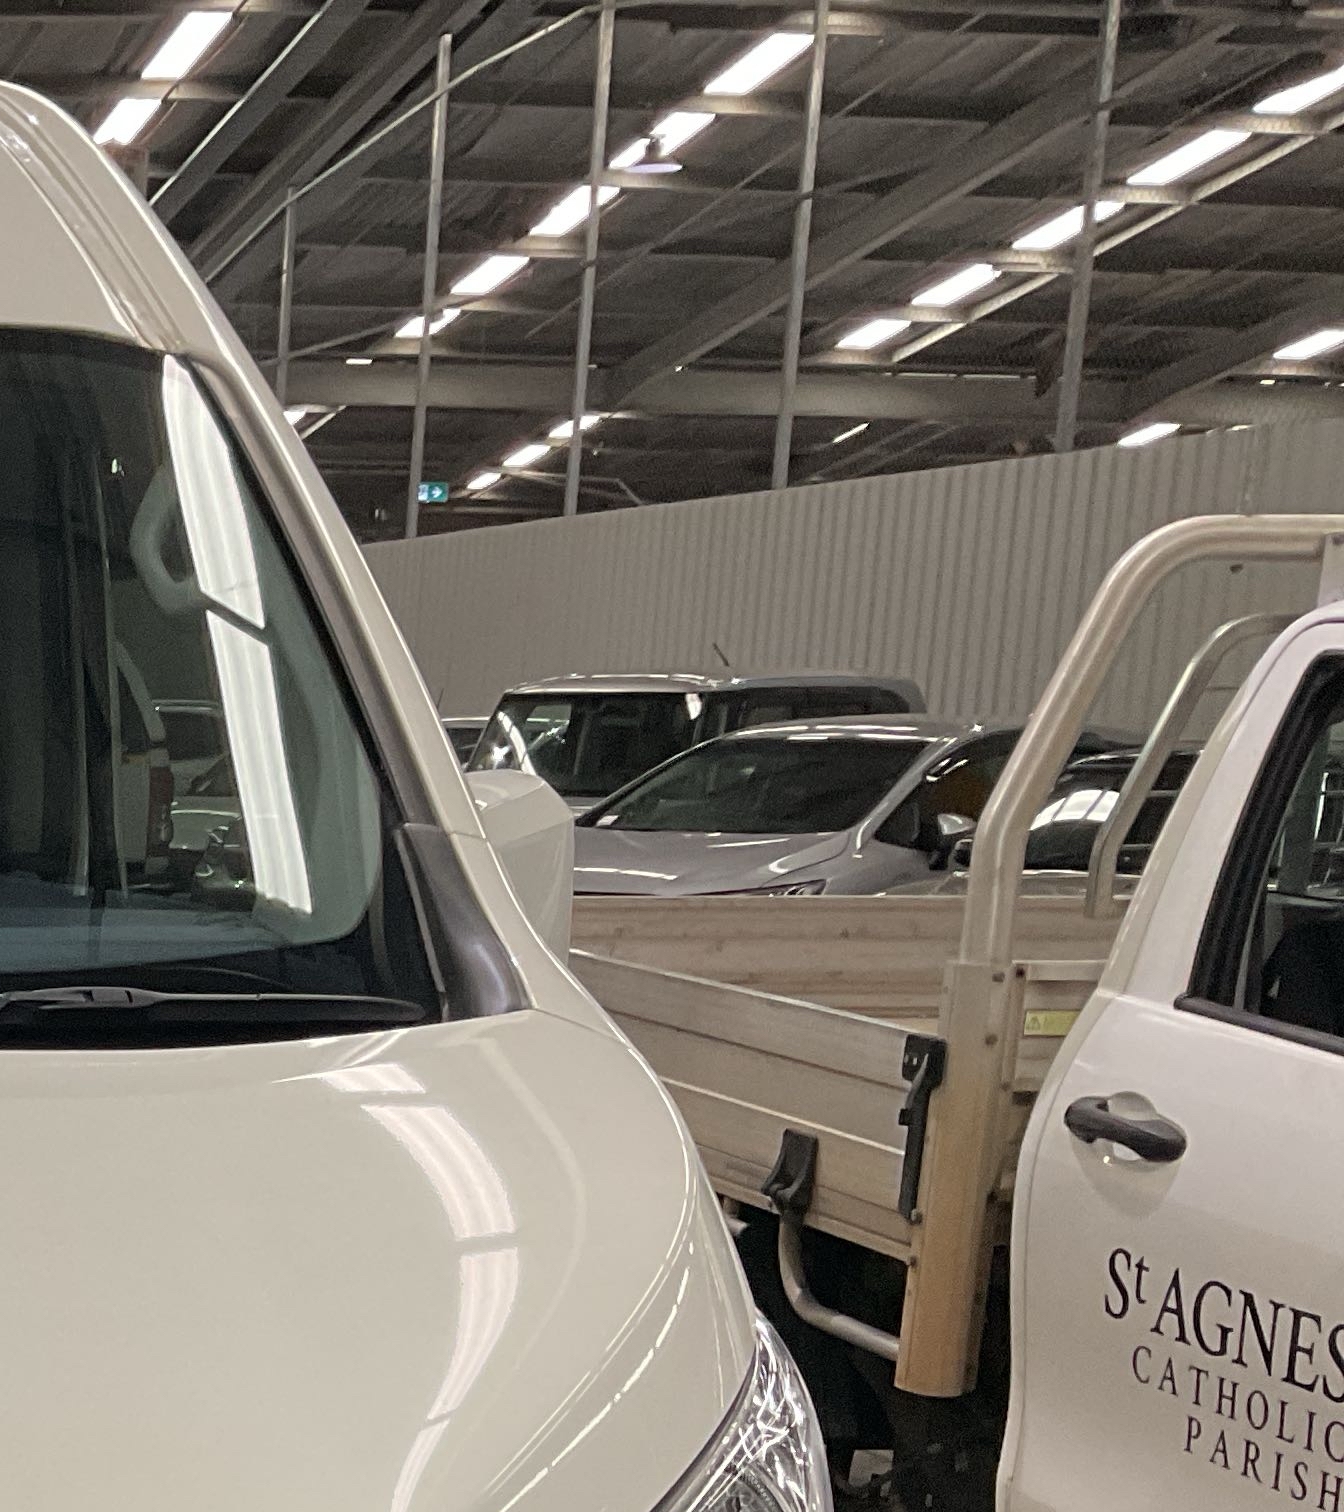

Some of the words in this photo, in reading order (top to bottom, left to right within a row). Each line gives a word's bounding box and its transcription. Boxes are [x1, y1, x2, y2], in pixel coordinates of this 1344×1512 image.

[1105, 1248, 1150, 1319] St
[1150, 1267, 1344, 1404] AGNES
[1131, 1345, 1344, 1464] CATHOLIC
